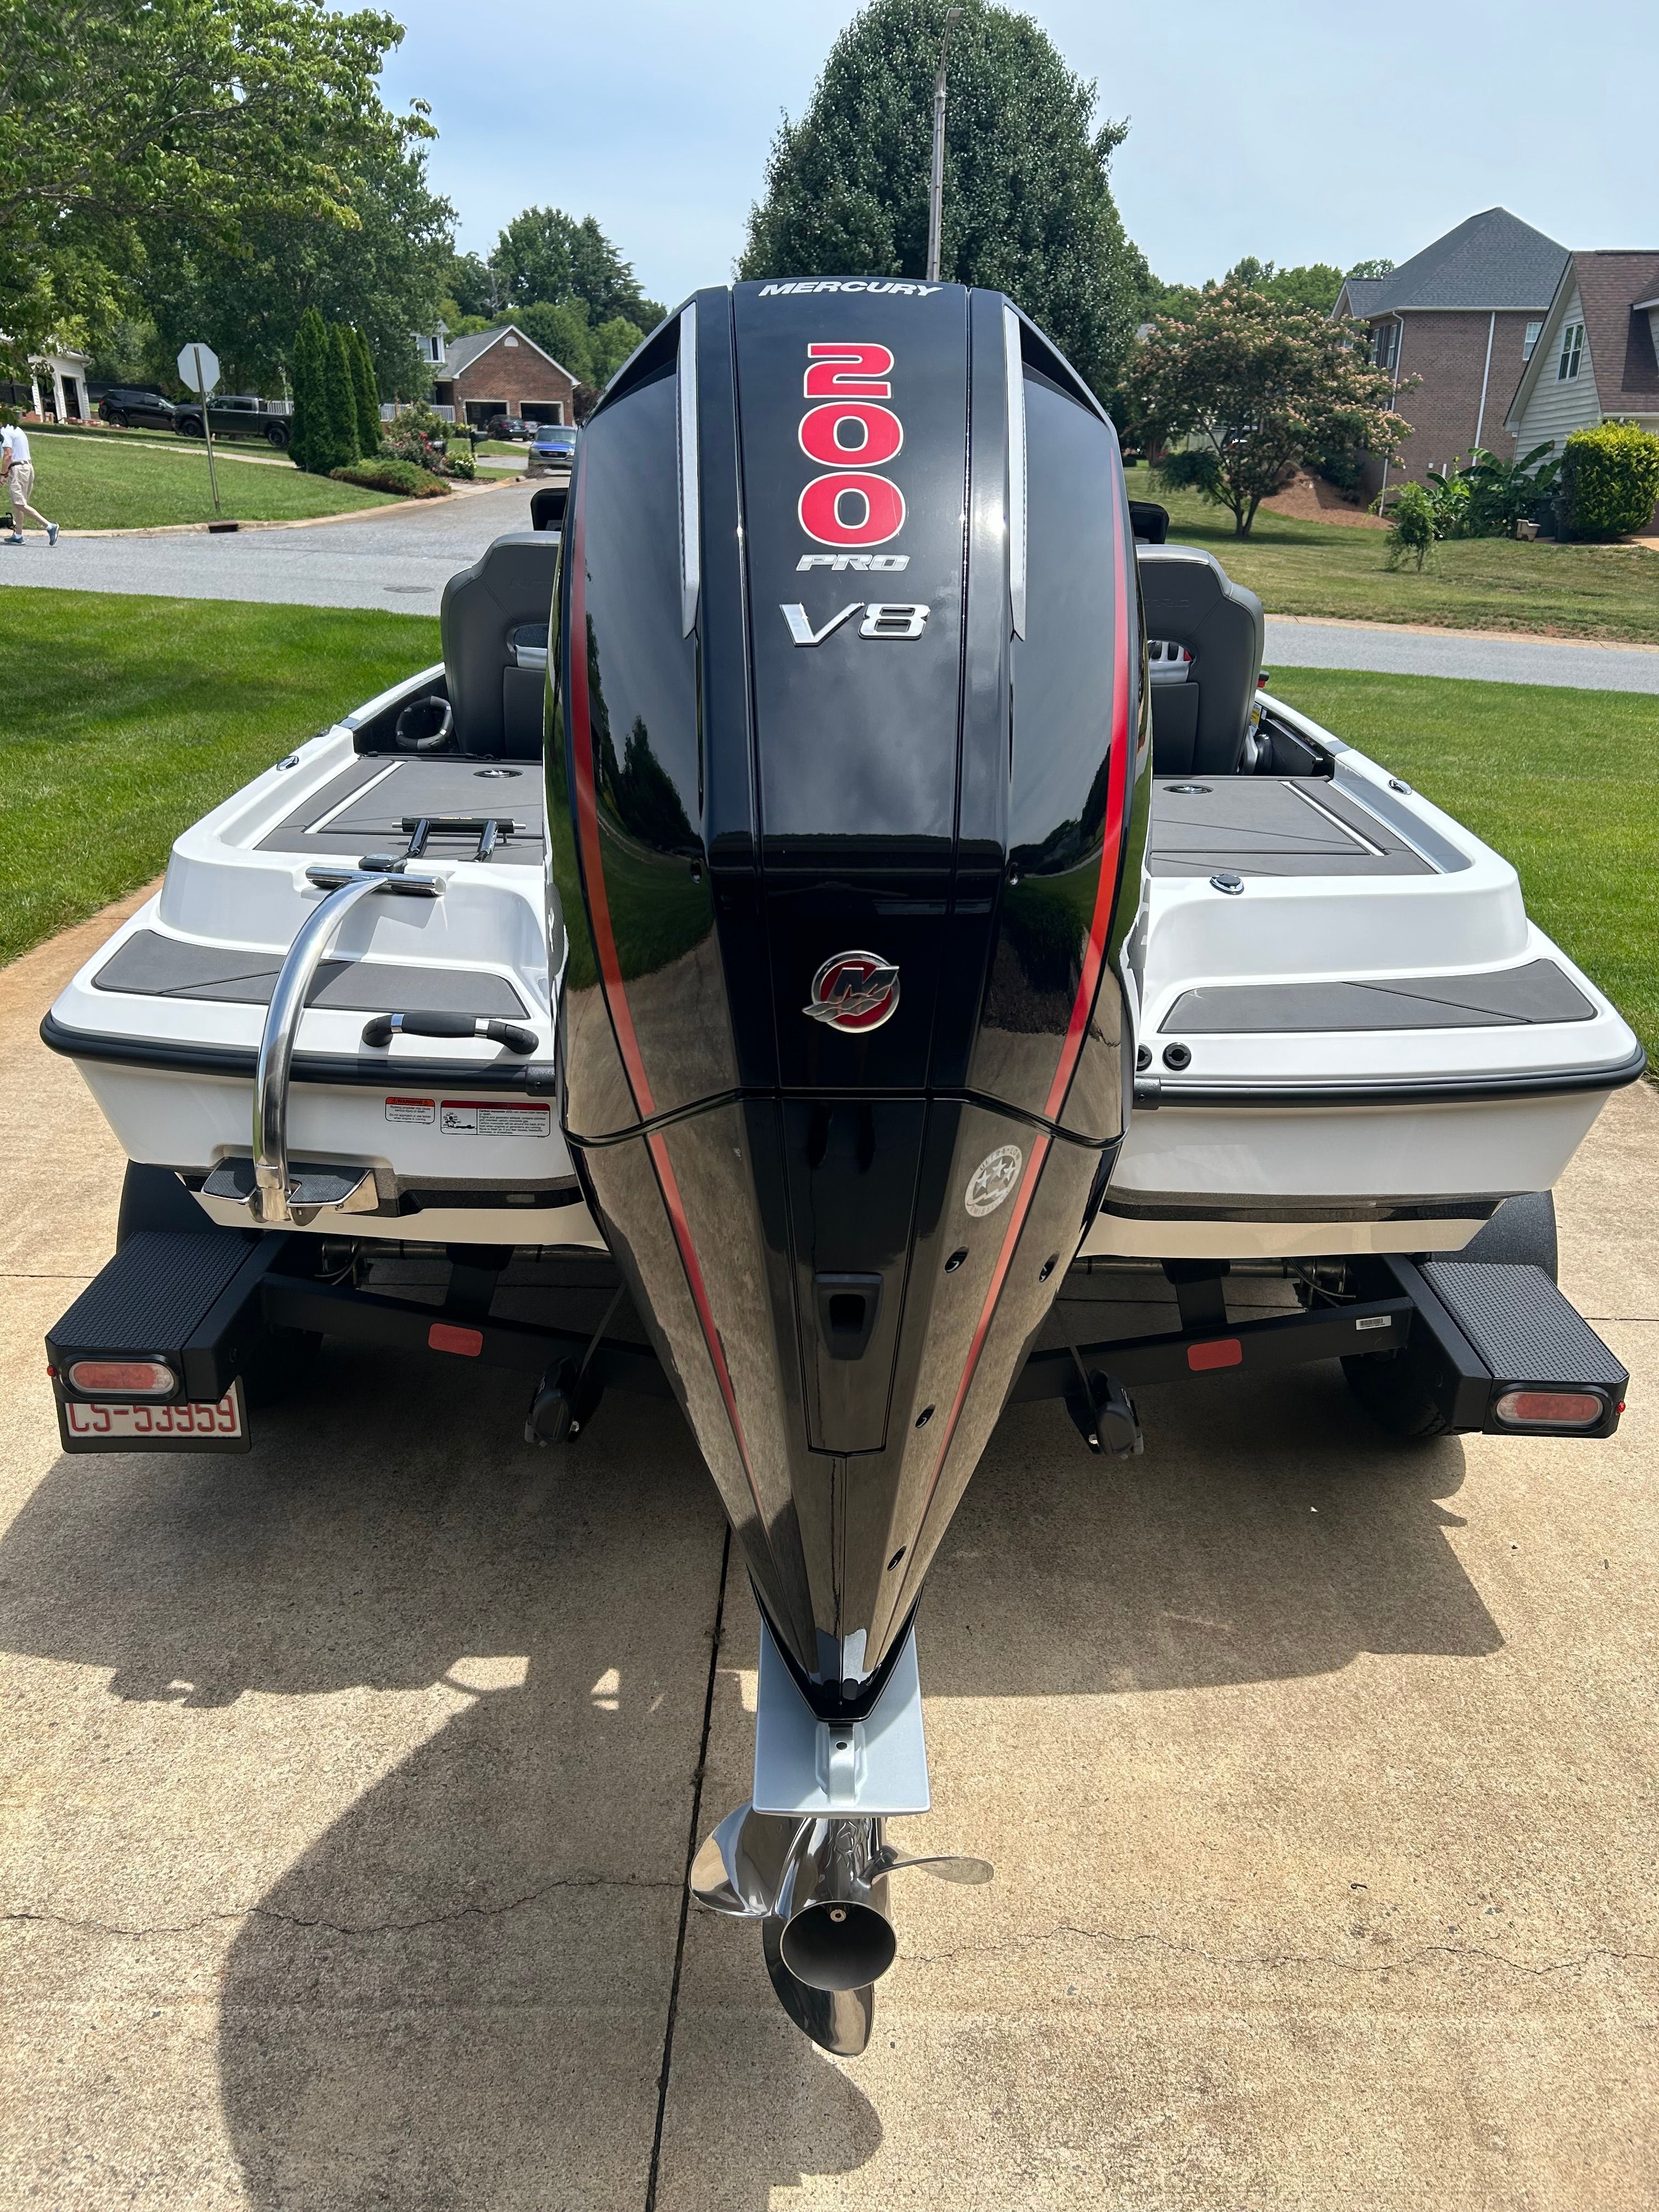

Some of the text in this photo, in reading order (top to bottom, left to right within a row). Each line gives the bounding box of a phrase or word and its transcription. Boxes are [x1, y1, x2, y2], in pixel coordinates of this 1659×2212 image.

[758, 281, 944, 297] MERCURY
[798, 343, 906, 548] 200
[796, 554, 910, 572] PRO
[779, 602, 932, 647] V8
[980, 1147, 1020, 1171] ULTRA-LOW
[69, 1394, 236, 1432] CS-53959
